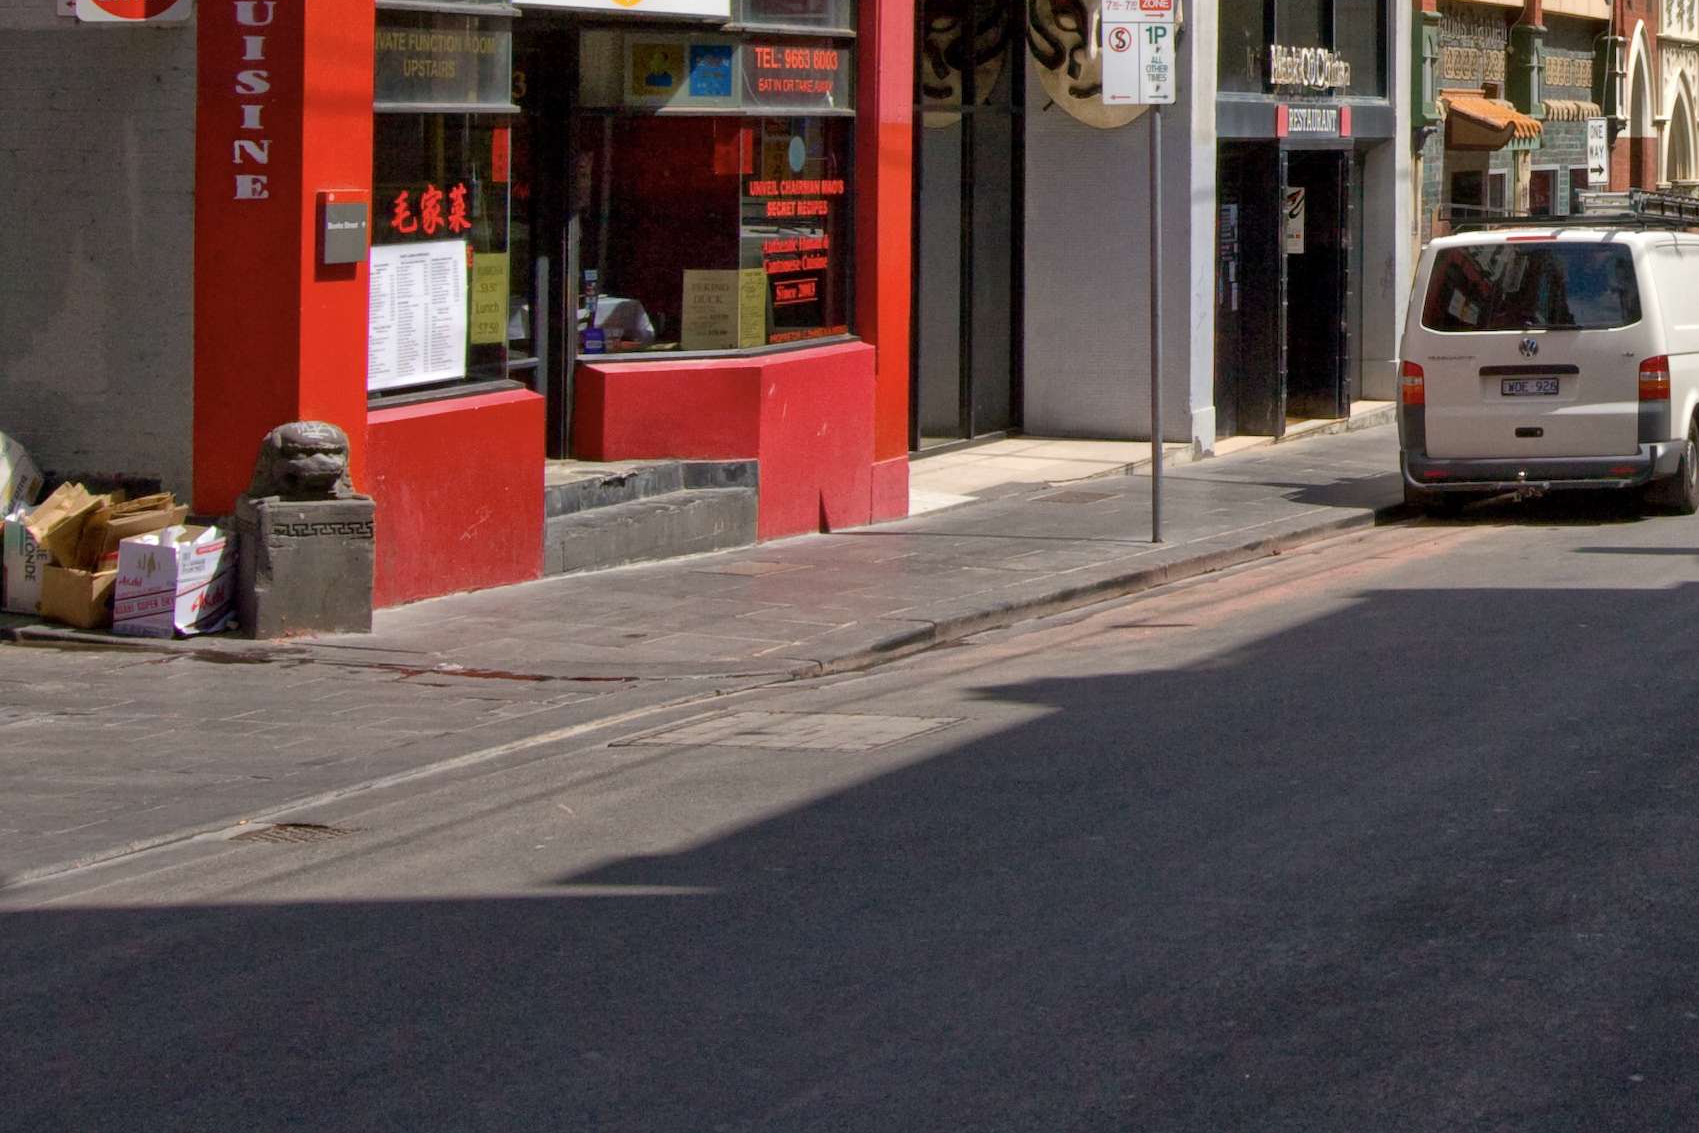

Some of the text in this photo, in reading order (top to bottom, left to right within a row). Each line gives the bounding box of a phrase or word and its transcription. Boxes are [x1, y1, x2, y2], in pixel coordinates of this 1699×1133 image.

[1142, 0, 1169, 8] ZONE
[408, 32, 463, 53] FUNCTION
[1145, 26, 1167, 45] 1P
[754, 46, 782, 69] TEL:
[1151, 56, 1163, 64] ALL
[403, 59, 457, 78] UPSTAIRS
[1146, 65, 1168, 73] OTHER
[1147, 74, 1167, 82] TIMES
[1288, 108, 1337, 132] RESTAURANT
[1590, 124, 1604, 139] ONE
[1590, 146, 1605, 159] WAY
[750, 180, 779, 196] UNVEIL
[780, 180, 820, 195] CHAIRMAN
[767, 200, 828, 217] SECRET RECIPES
[776, 285, 798, 302] Since
